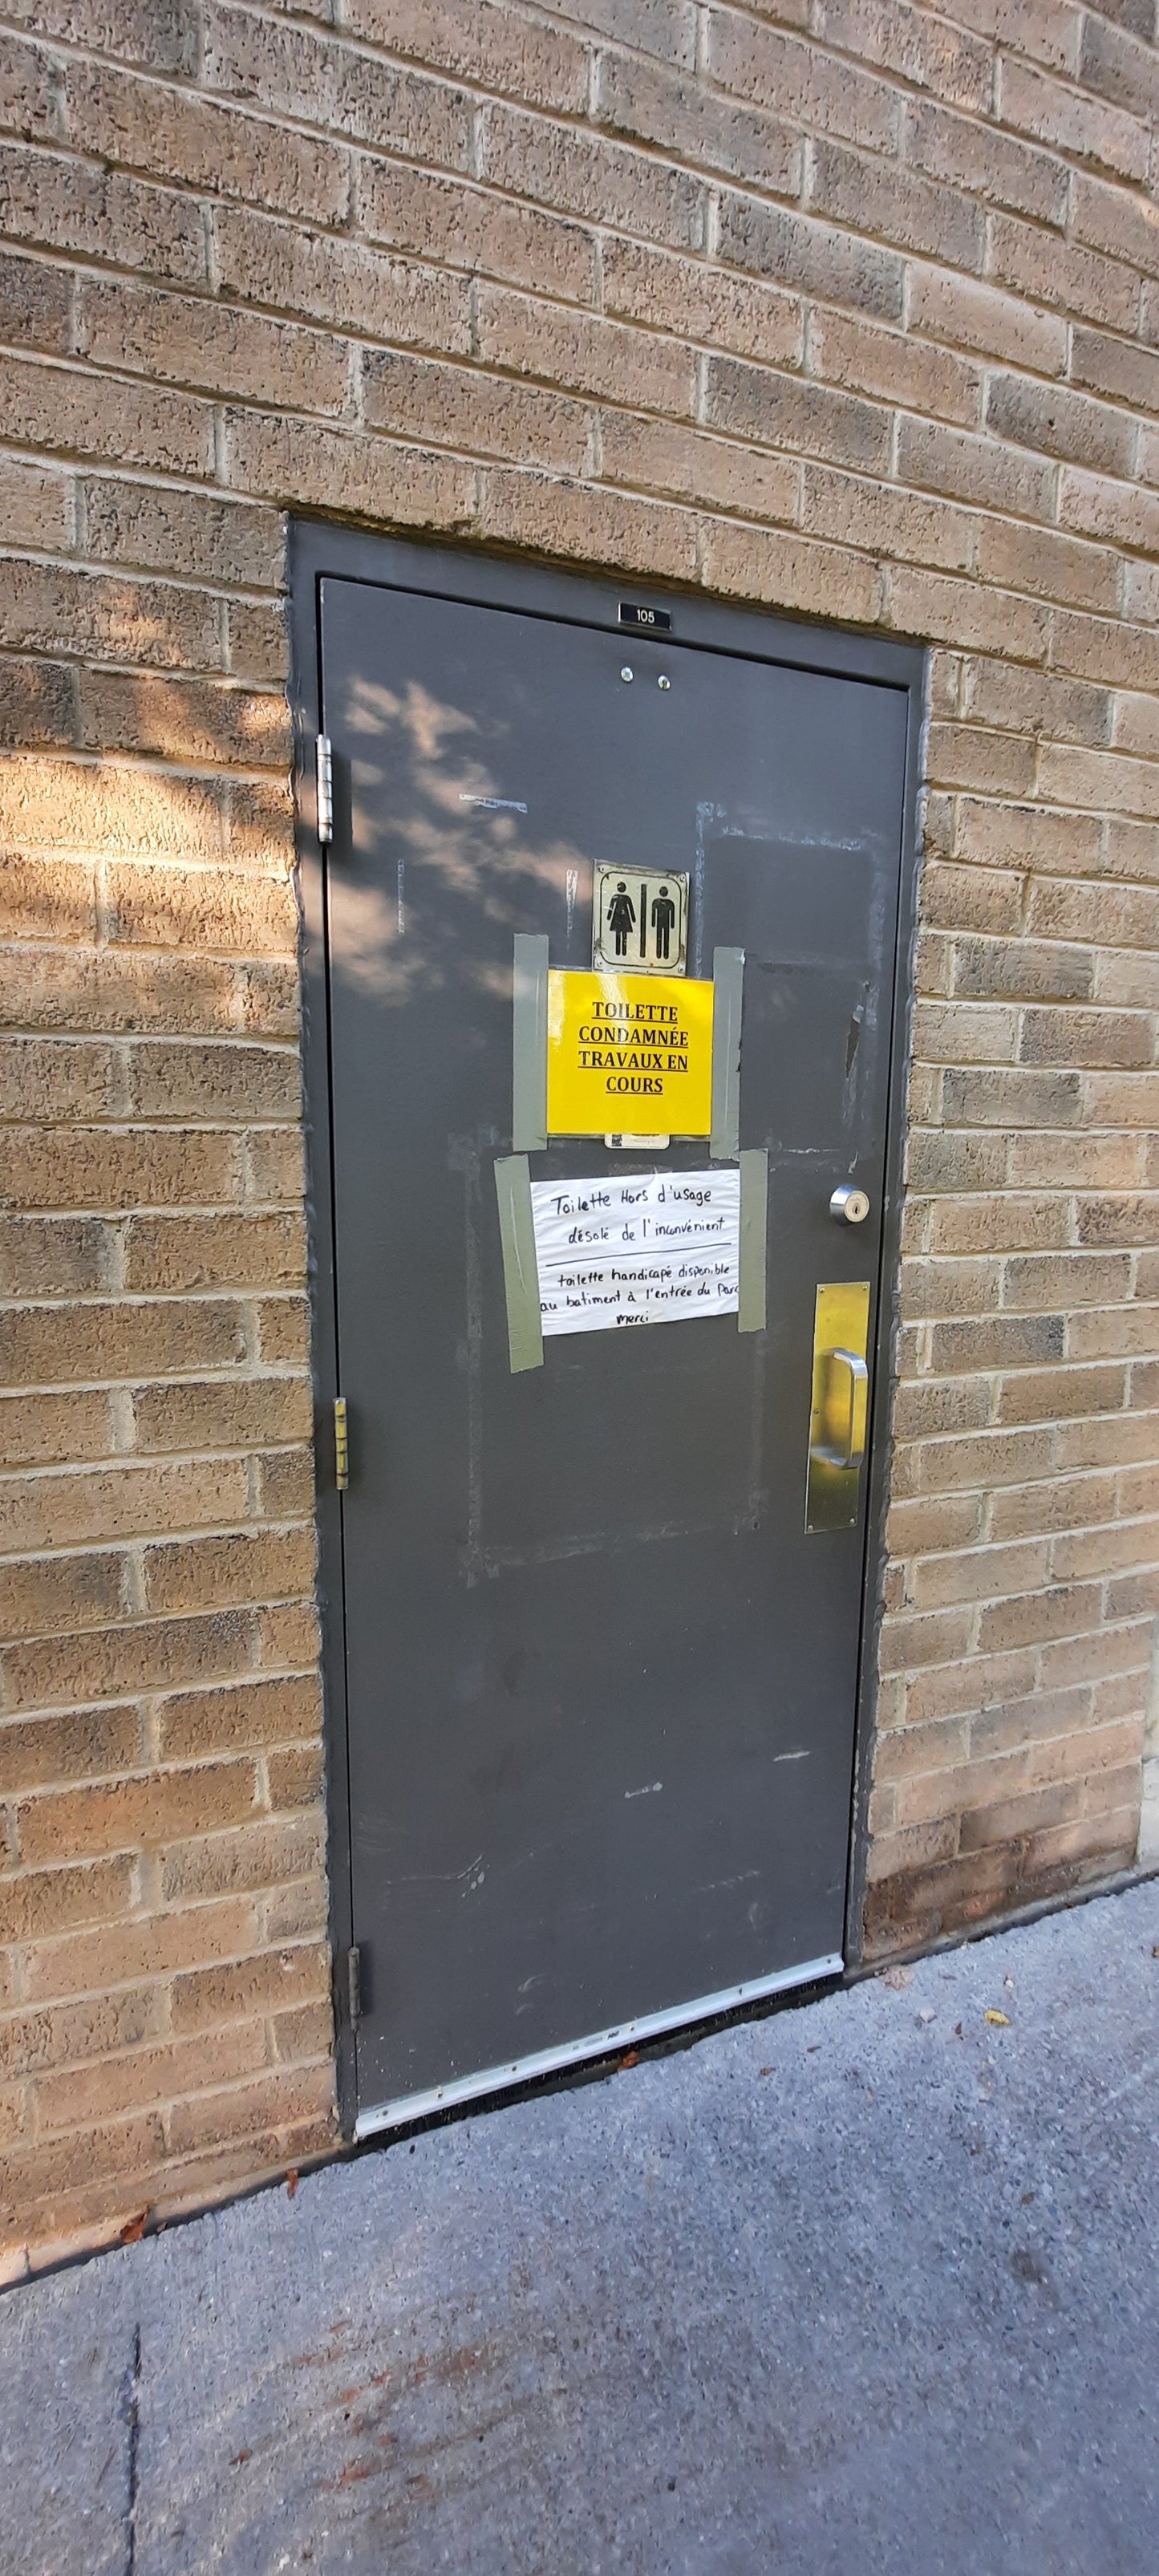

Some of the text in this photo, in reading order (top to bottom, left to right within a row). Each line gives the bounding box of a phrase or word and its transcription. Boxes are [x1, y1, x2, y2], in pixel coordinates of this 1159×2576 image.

[637, 609, 655, 623] 105
[591, 1001, 679, 1024] TOILETTE
[578, 1025, 689, 1048] CONDAMNÉE
[577, 1050, 688, 1072] TRAVAUX EN
[606, 1076, 663, 1095] COURS
[550, 1183, 712, 1215] Toilette Hors d'usage
[568, 1216, 726, 1243] désolé de l'inconvénient
[557, 1263, 730, 1288] toilette handicapé disponible
[540, 1302, 558, 1312] au
[566, 1289, 621, 1308] batiment
[627, 1291, 637, 1303] à
[646, 1284, 692, 1300] l'entrée
[697, 1281, 710, 1296] du
[616, 1310, 649, 1325] merci
